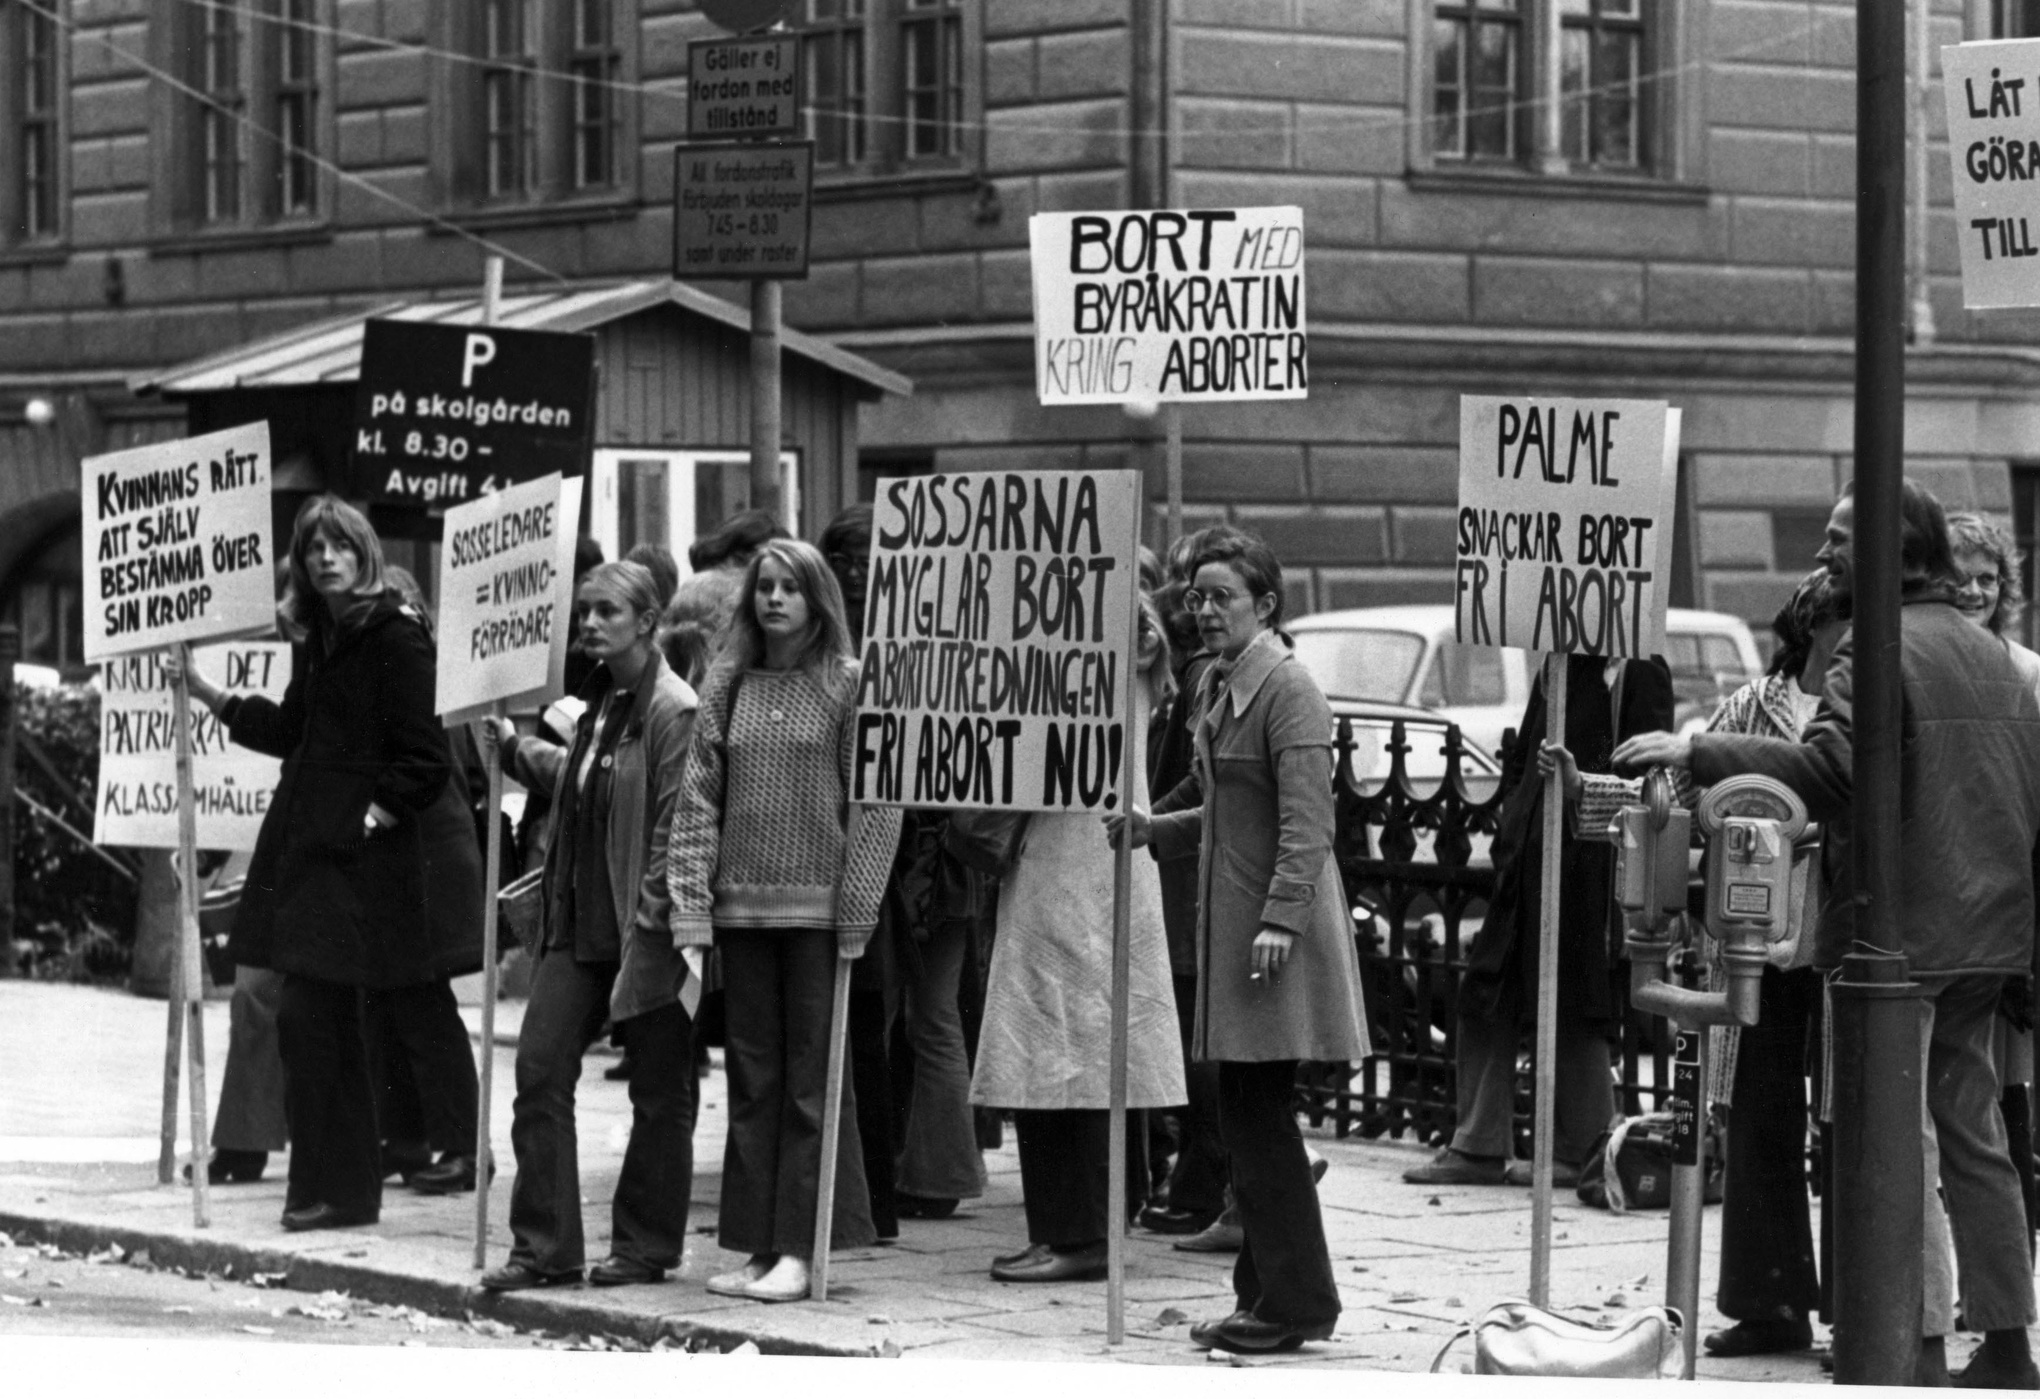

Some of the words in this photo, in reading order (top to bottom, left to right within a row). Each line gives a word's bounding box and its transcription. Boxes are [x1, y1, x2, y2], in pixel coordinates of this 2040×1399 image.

[705, 47, 758, 70] Gäller
[764, 44, 781, 70] ej
[693, 77, 750, 101] fordon
[756, 74, 793, 97] med
[1965, 67, 2025, 119] LÅT
[707, 104, 777, 128] tillstånd
[1966, 136, 2040, 184] GÖRA
[1070, 210, 1237, 274] BORT
[1233, 226, 1302, 270] MED
[1971, 217, 2039, 260] TILL
[1074, 272, 1299, 334] BYRÅKRATIN
[461, 333, 496, 388] P
[1045, 337, 1137, 396] KRING
[1159, 332, 1308, 393] ABORTER
[371, 390, 406, 419] på
[416, 393, 571, 427] skolgården
[357, 428, 387, 454] kl.
[404, 431, 469, 461] 8.30
[1498, 403, 1620, 487] PALME
[385, 469, 467, 501] Avgift
[98, 523, 131, 562] ATT
[136, 505, 200, 550] SJÄLV
[879, 474, 1101, 555] SOSSARNA
[1457, 506, 1563, 563] SNACKAR
[1577, 513, 1653, 569] BORT
[100, 544, 204, 600] BESTÄMMA
[212, 533, 262, 573] ÖVER
[105, 598, 140, 637] SIN
[147, 584, 212, 628] KROPP
[866, 553, 992, 641] MYGLAR
[1012, 555, 1115, 642] BORT
[1533, 566, 1652, 659] ABORT
[471, 603, 554, 662] FÖRRÄDARE
[227, 650, 276, 689] DET
[856, 640, 1116, 718] ABORTUTREDNINGEN
[854, 713, 906, 801] FRI
[914, 715, 1021, 805] ABORT
[1043, 722, 1122, 810] NU!
[104, 776, 276, 816] KLASSMHÄLLE
